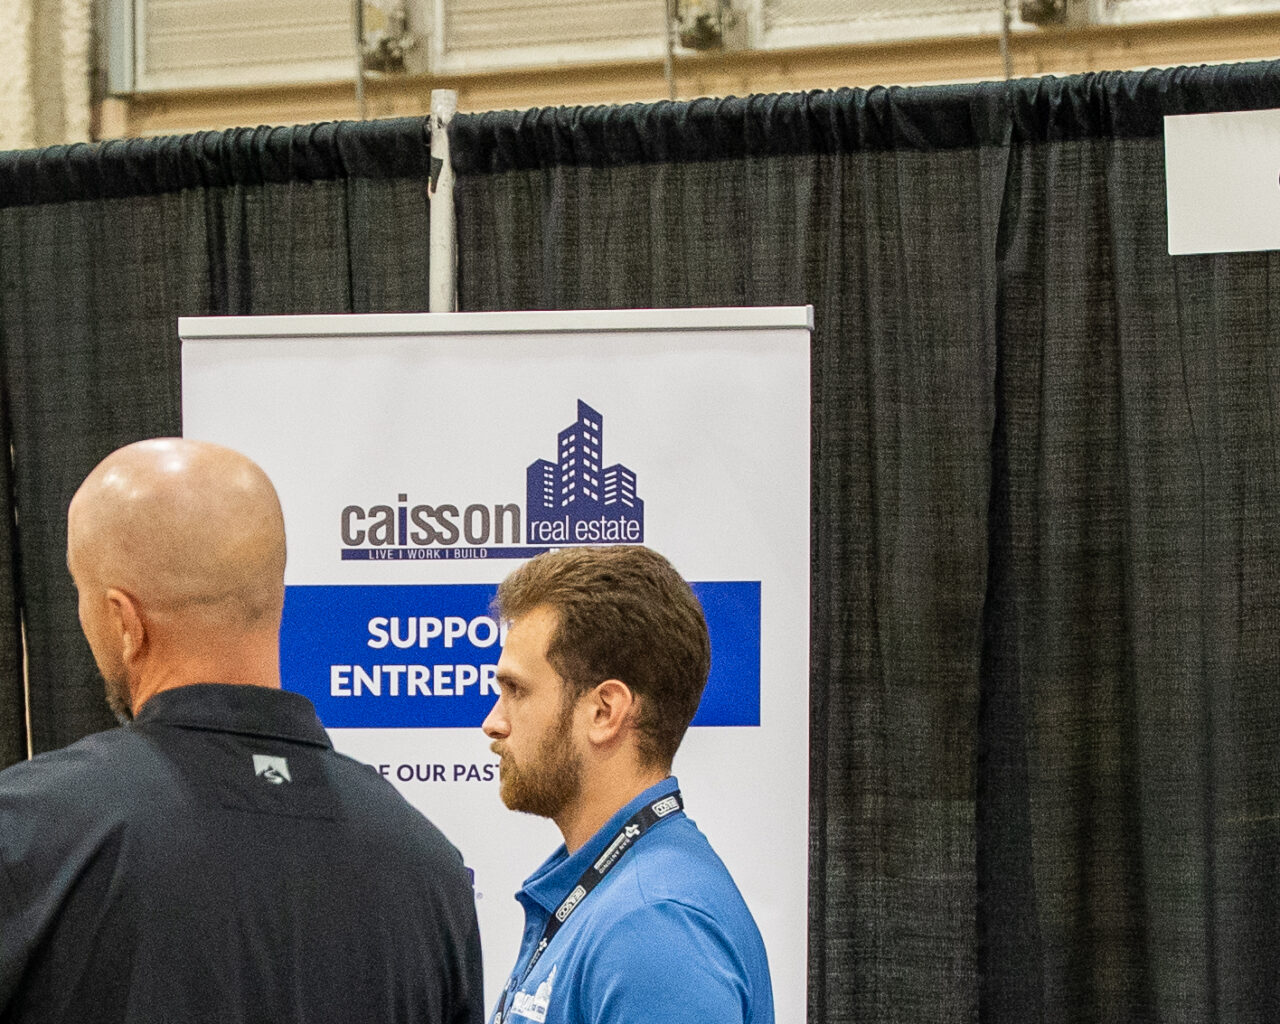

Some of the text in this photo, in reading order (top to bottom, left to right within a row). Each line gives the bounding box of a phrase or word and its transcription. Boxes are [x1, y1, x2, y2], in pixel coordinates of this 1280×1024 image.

[341, 493, 520, 546] caisson
[531, 515, 640, 541] real estate
[369, 549, 393, 560] LIVE
[407, 549, 441, 559] WORK
[454, 548, 488, 559] BUILD
[397, 764, 446, 782] OUR
[453, 764, 499, 782] PAS
